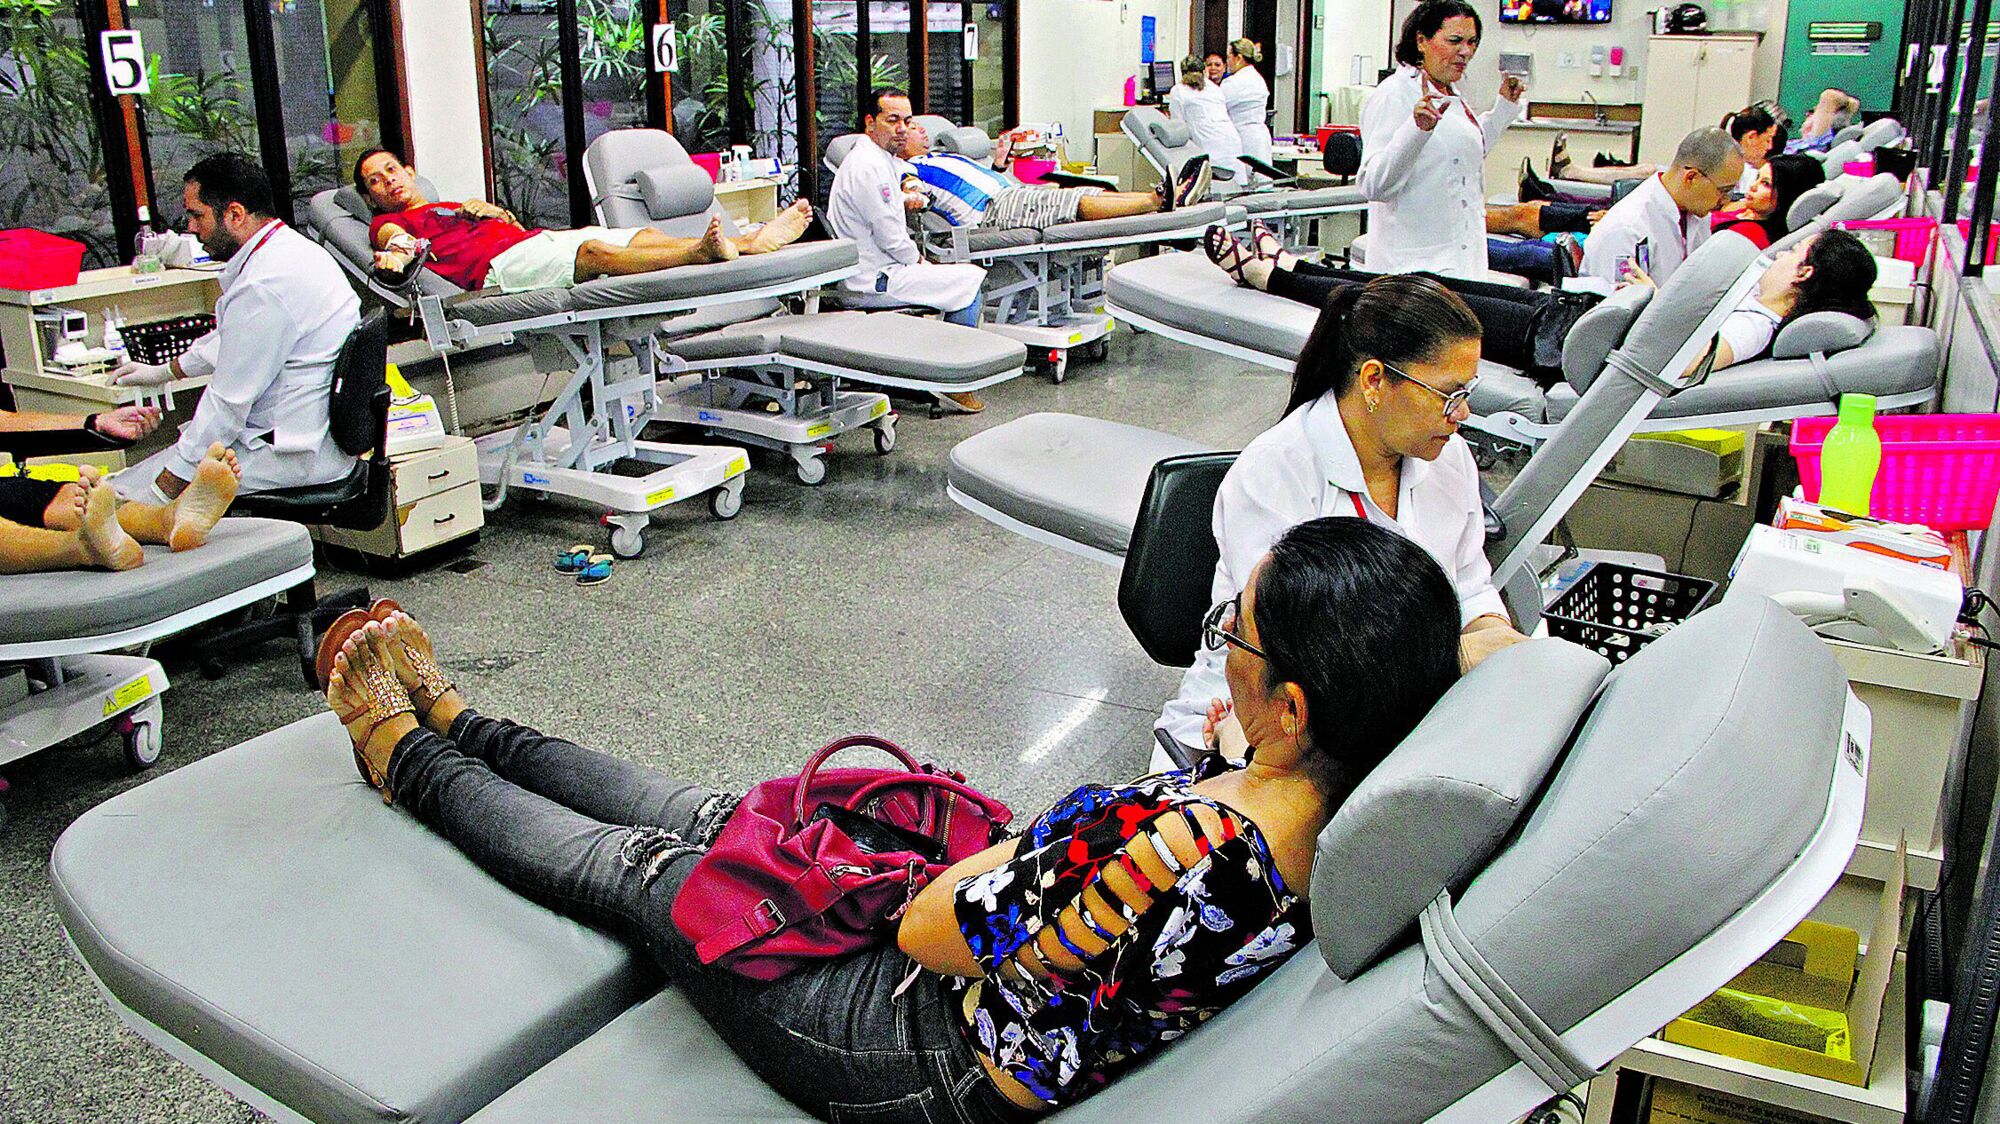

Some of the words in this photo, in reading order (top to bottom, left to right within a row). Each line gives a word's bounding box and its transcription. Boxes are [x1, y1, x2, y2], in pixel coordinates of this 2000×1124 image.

[657, 27, 673, 68] 6
[967, 26, 975, 57] 7
[108, 35, 141, 89] 5
[1697, 1093, 1746, 1112] COLETOR
